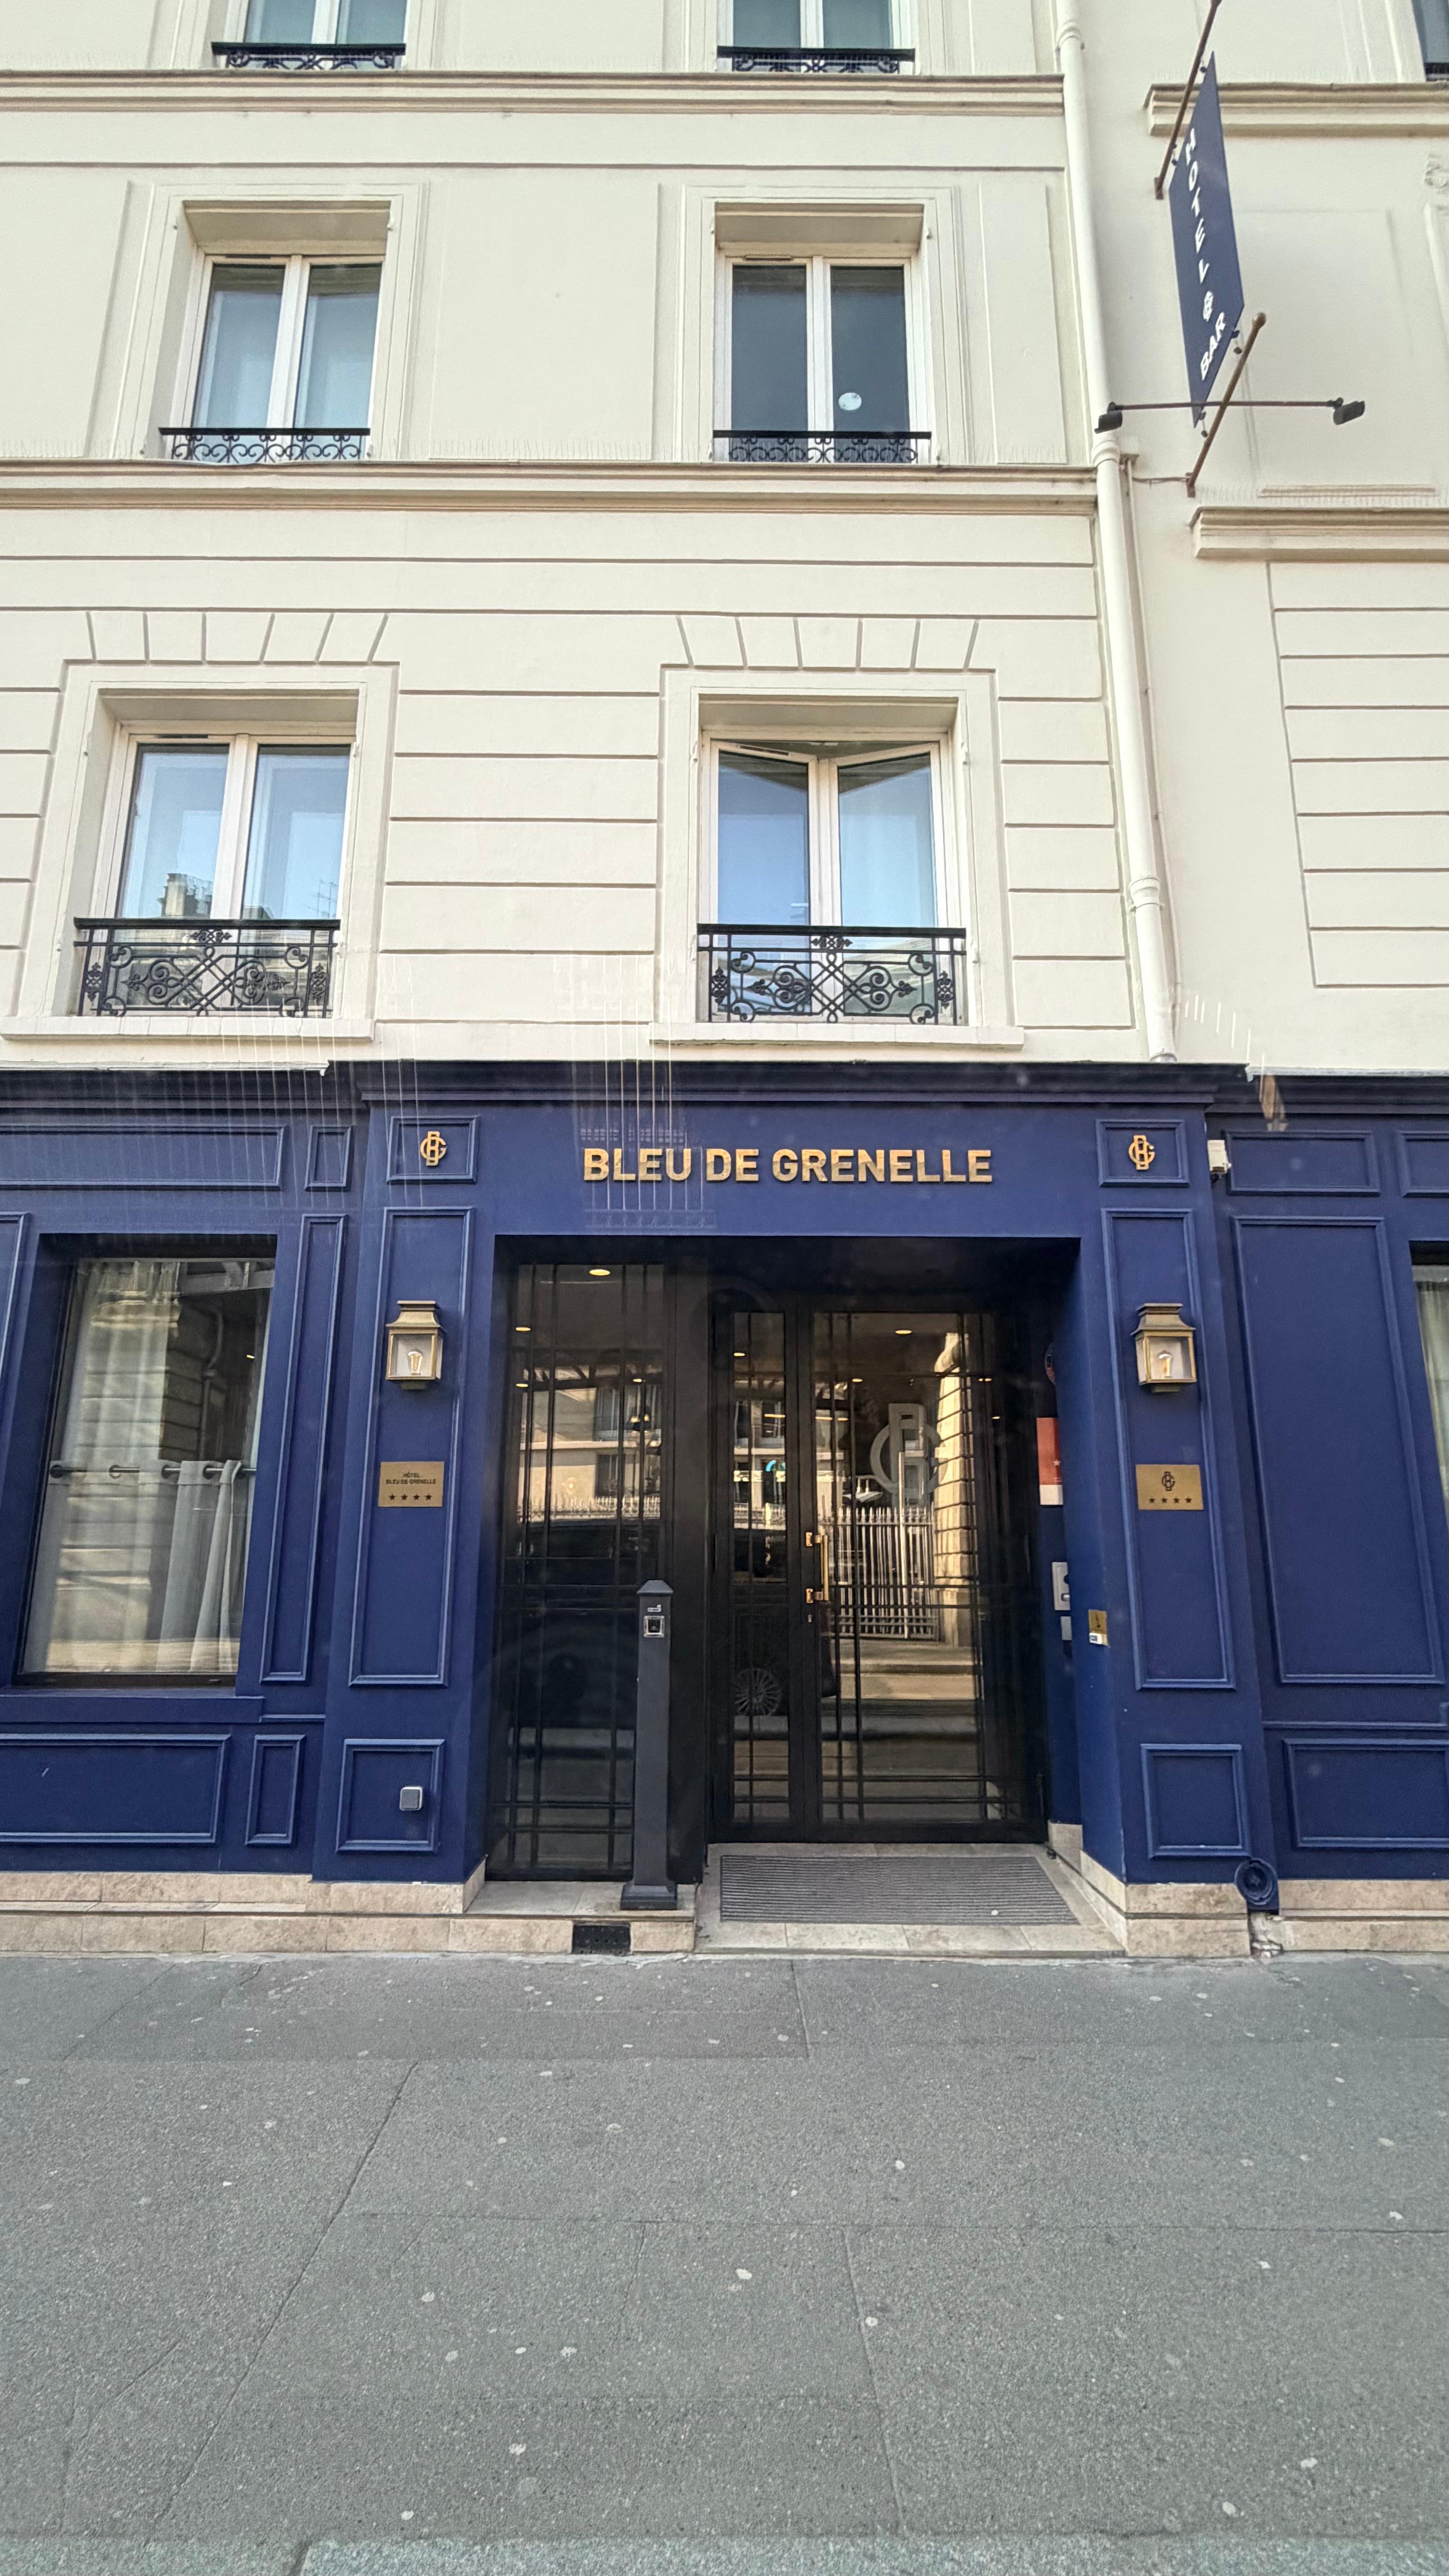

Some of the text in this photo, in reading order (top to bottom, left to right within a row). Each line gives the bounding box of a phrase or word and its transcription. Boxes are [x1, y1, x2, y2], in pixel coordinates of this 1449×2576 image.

[1201, 312, 1225, 380] BAR
[584, 1148, 992, 1182] BLEU DE GRENELLE
